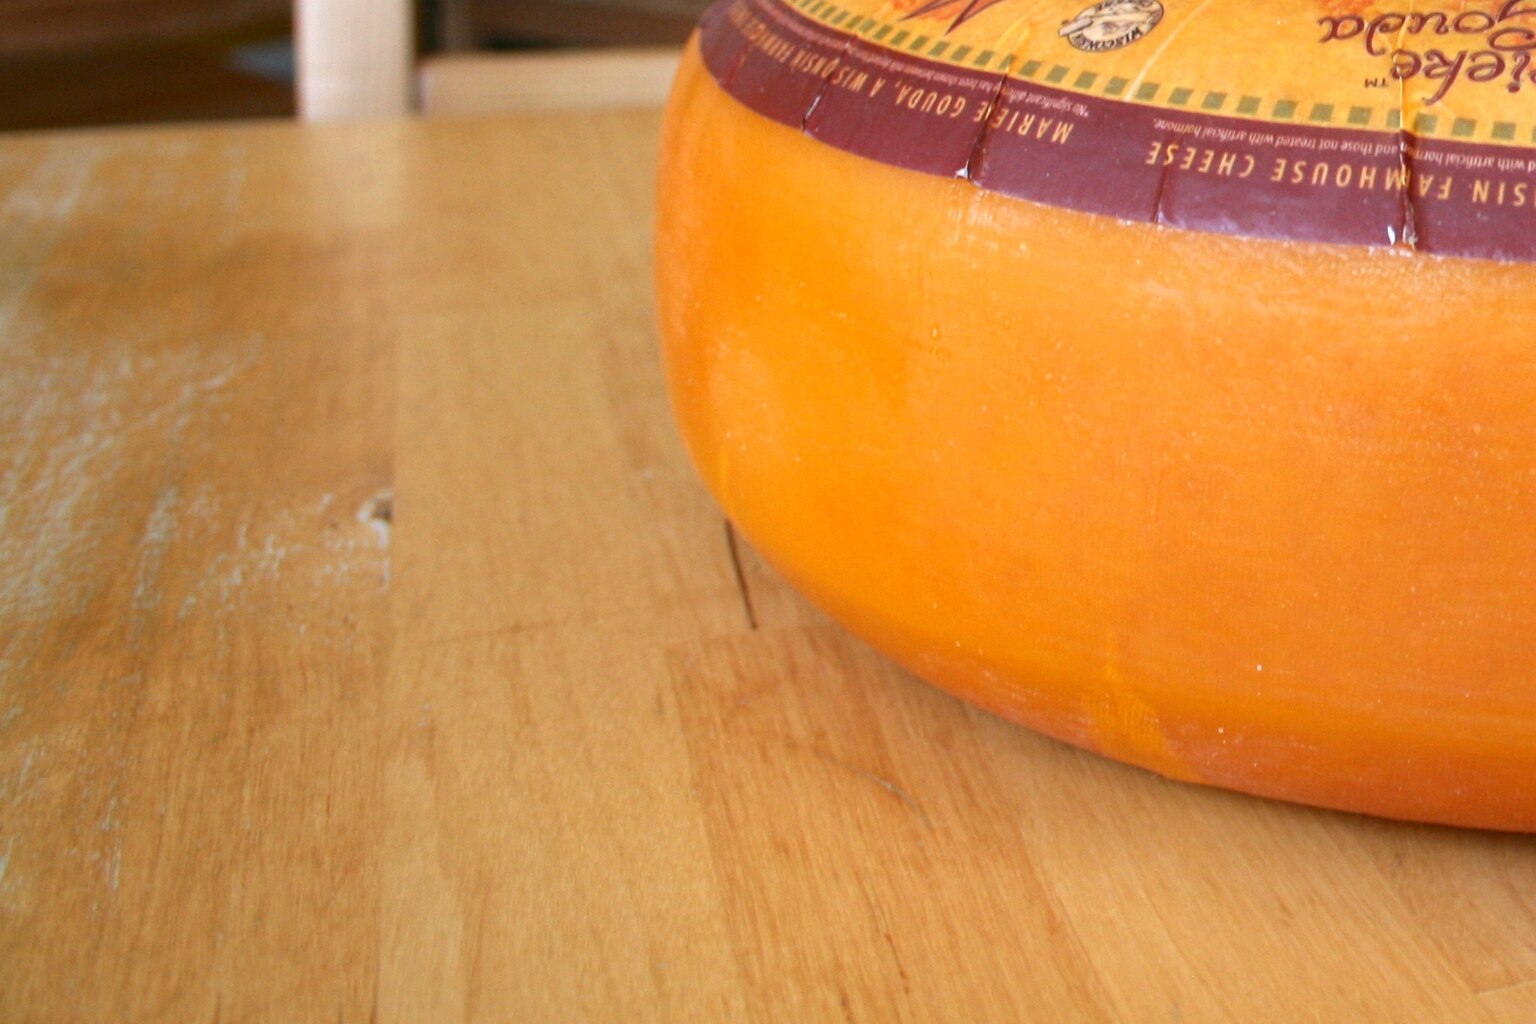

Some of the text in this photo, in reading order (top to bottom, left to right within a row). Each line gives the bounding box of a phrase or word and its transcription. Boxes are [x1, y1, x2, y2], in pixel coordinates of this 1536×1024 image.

[789, 49, 869, 93] WISONSIN
[869, 77, 887, 98] A
[895, 79, 967, 118] GOUDA,
[1152, 118, 1202, 139] hormone.
[1201, 125, 1248, 144] artificial
[1248, 131, 1274, 147] with
[1275, 134, 1317, 151] treated
[1317, 137, 1339, 152] not
[1340, 141, 1374, 157] those
[1374, 143, 1399, 158] and
[1144, 140, 1256, 179] CHEESE
[1446, 152, 1496, 171] artificial
[1497, 158, 1526, 174] with
